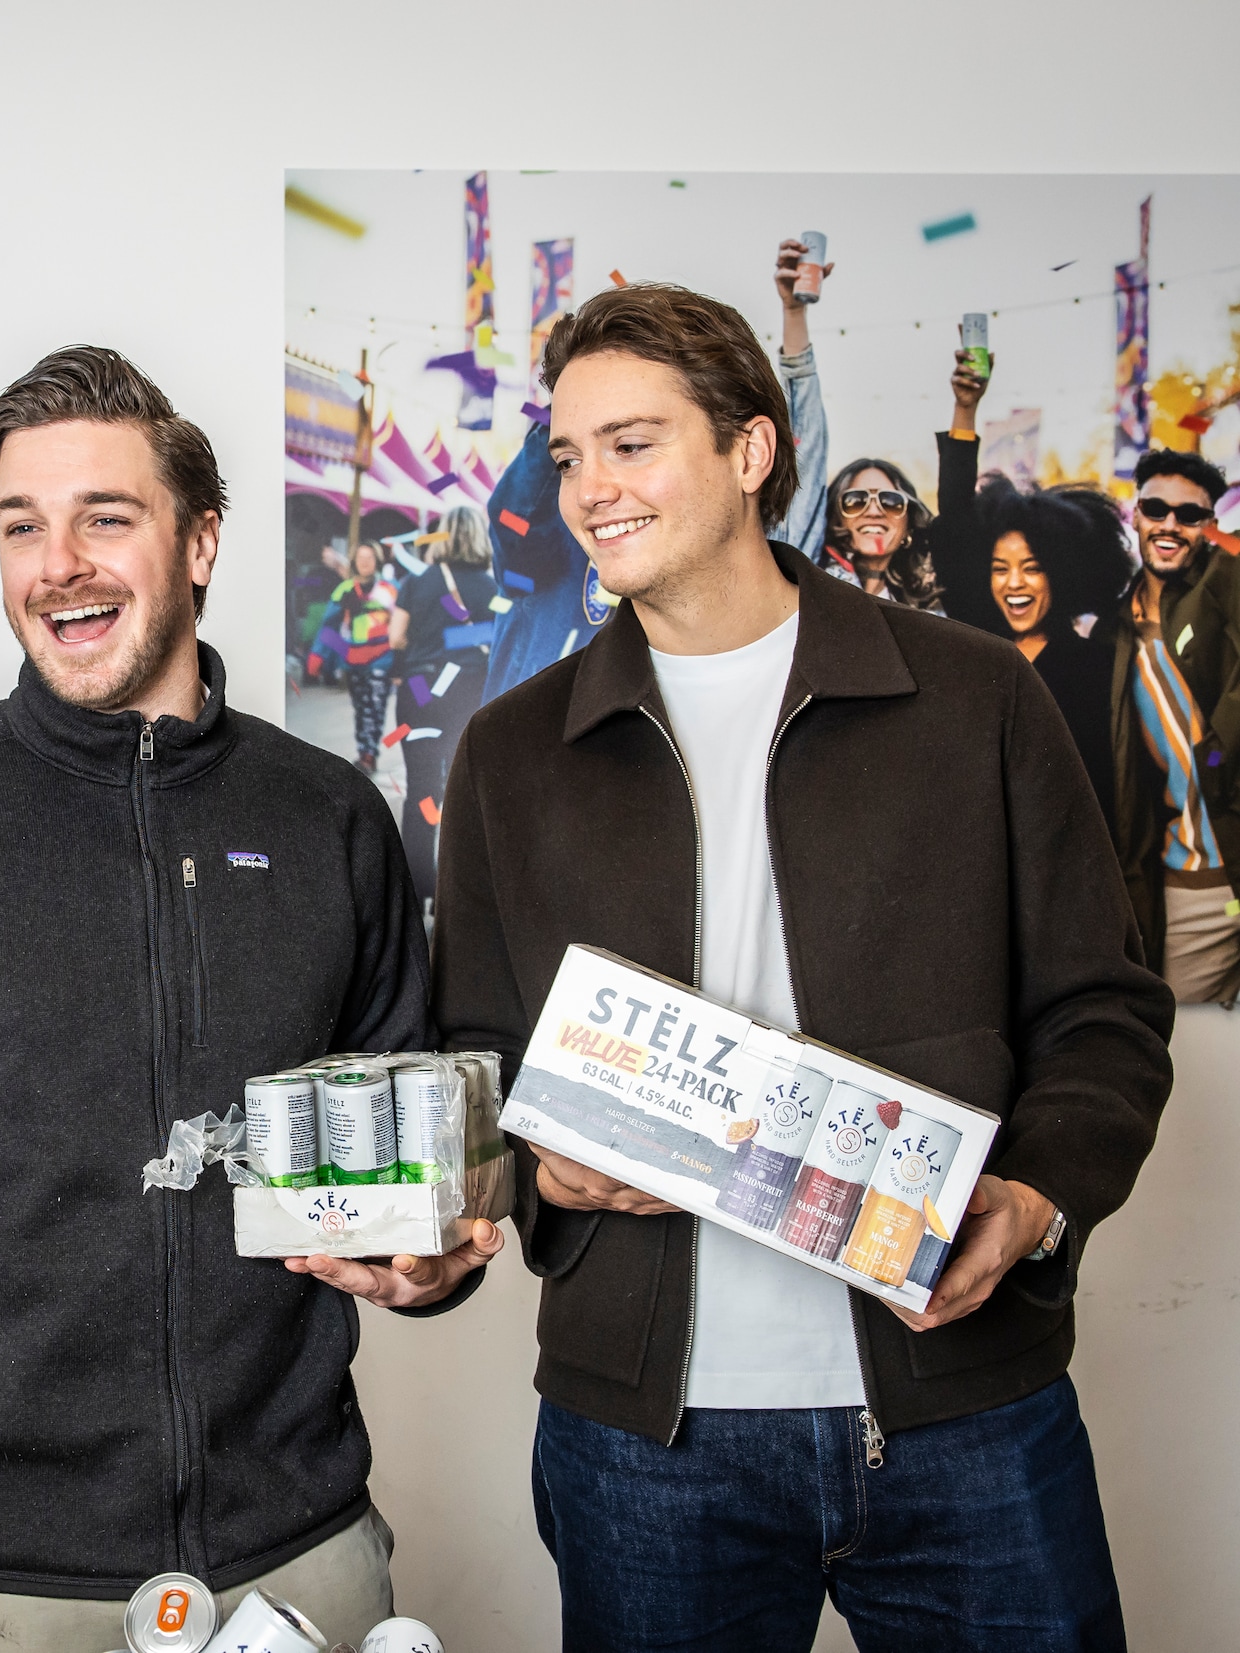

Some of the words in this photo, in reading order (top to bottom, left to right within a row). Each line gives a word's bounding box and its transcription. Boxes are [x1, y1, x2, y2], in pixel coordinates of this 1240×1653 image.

[587, 987, 739, 1078] STËLZ
[559, 1025, 643, 1074] VALUE
[641, 1055, 743, 1114] 24-PACK
[582, 1062, 598, 1077] 63
[599, 1069, 624, 1090] CAL.
[635, 1085, 665, 1107] 4.5%
[666, 1099, 693, 1120] ALC.
[765, 1081, 813, 1119] STËLZ
[605, 1107, 626, 1121] HARD
[626, 1116, 656, 1134] SELTZER
[828, 1107, 877, 1146] STËLZ
[836, 1154, 866, 1167] SELTZER
[892, 1134, 941, 1174] STËLZ
[732, 1170, 783, 1198] PASSIONFRUIT
[889, 1167, 900, 1187] HARD
[900, 1181, 931, 1194] SELTZER
[308, 1191, 359, 1221] STËLZ
[795, 1199, 844, 1227] RASPBERRY
[870, 1231, 899, 1250] MANGO
